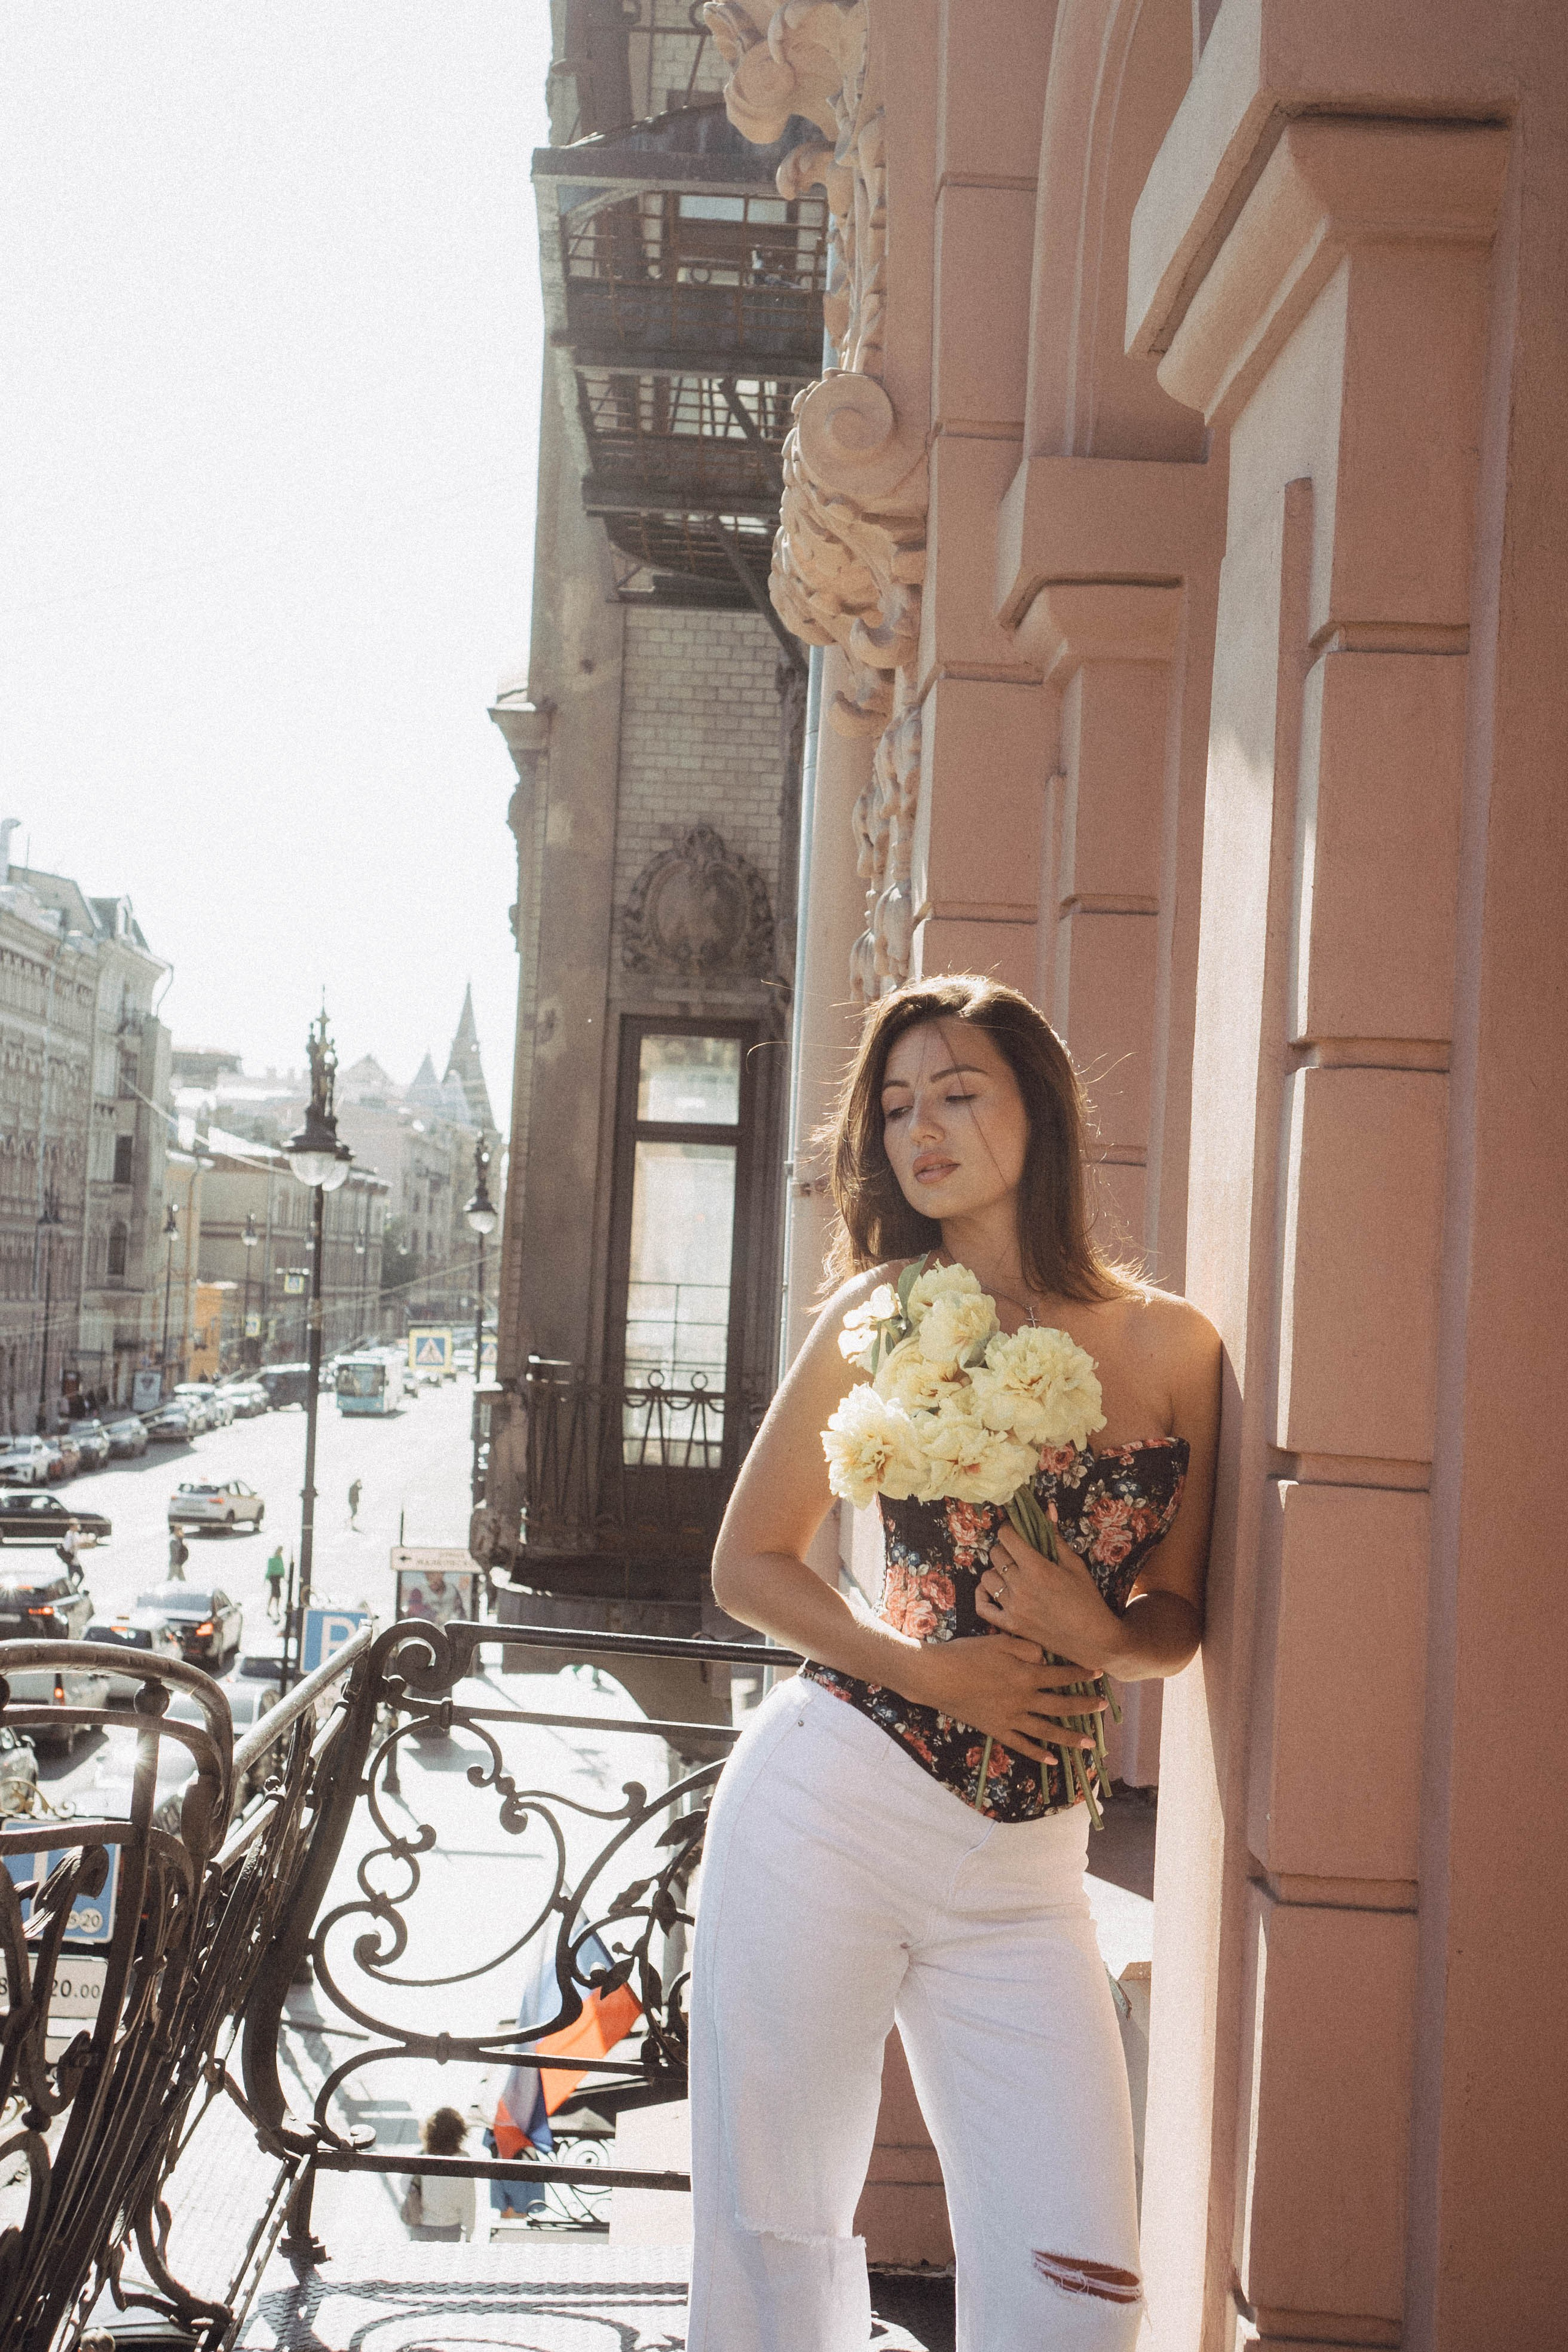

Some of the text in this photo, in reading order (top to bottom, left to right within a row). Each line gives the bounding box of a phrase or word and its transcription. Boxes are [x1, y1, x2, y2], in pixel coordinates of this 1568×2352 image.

[320, 1616, 357, 1664] P
[81, 1913, 100, 1928] 20
[51, 1979, 100, 1999] 20.00
